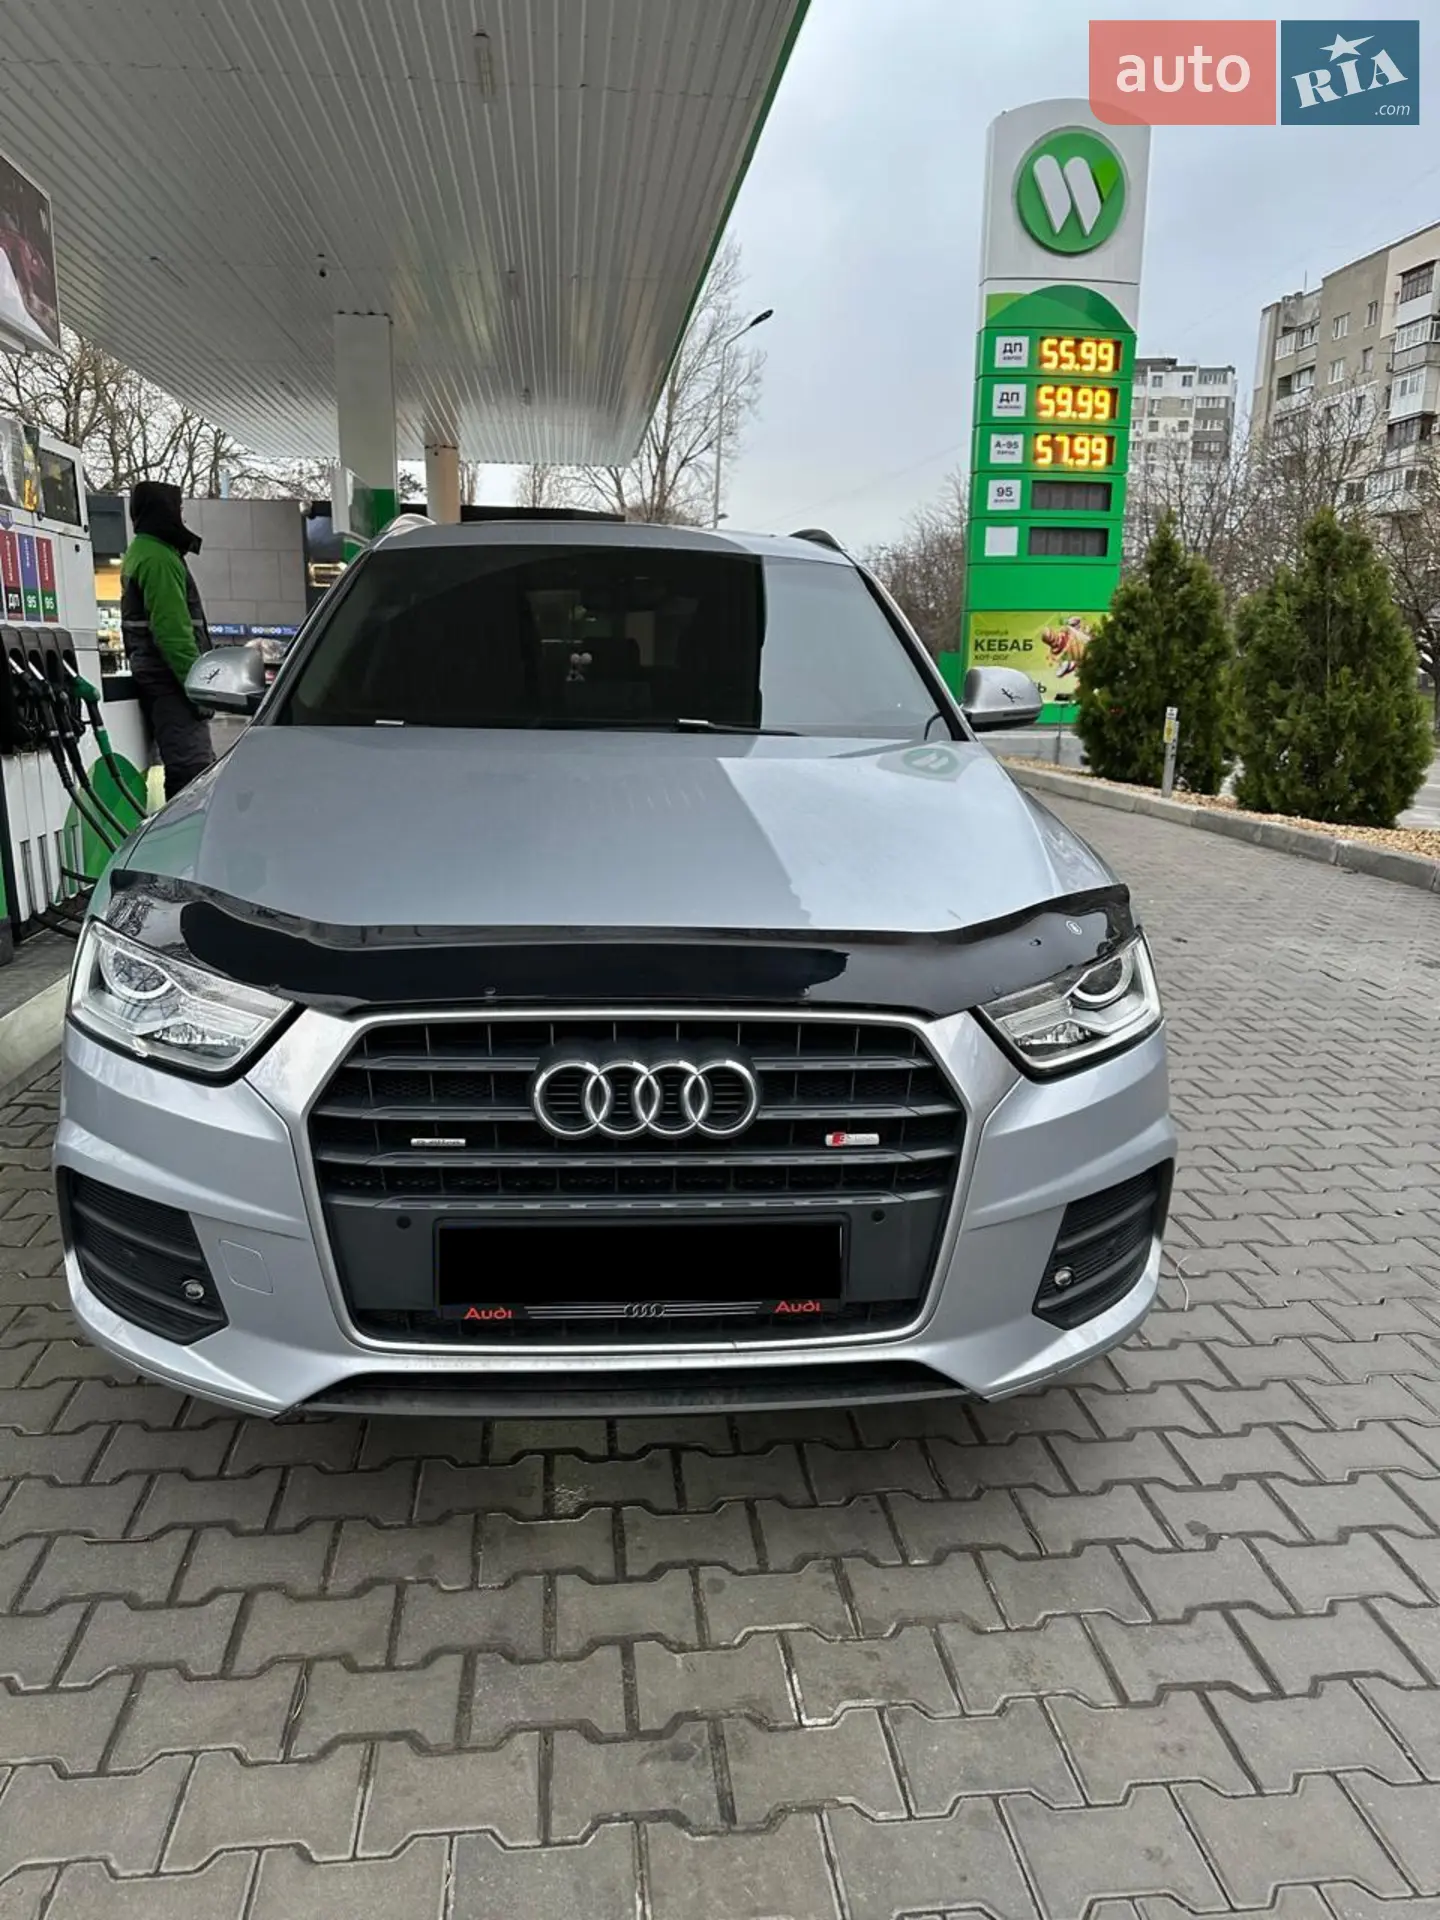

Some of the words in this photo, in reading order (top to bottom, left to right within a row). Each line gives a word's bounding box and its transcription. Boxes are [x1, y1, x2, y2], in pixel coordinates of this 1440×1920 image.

[1002, 342, 1022, 354] ДП
[1041, 338, 1114, 373] 55.99
[999, 391, 1020, 404] ДП
[1037, 385, 1111, 420] 59.99
[1035, 434, 1108, 467] 57.99
[996, 487, 1013, 497] 95
[974, 639, 1033, 652] КЕБАБ
[464, 1306, 513, 1320] Audi
[775, 1300, 821, 1313] Audi
